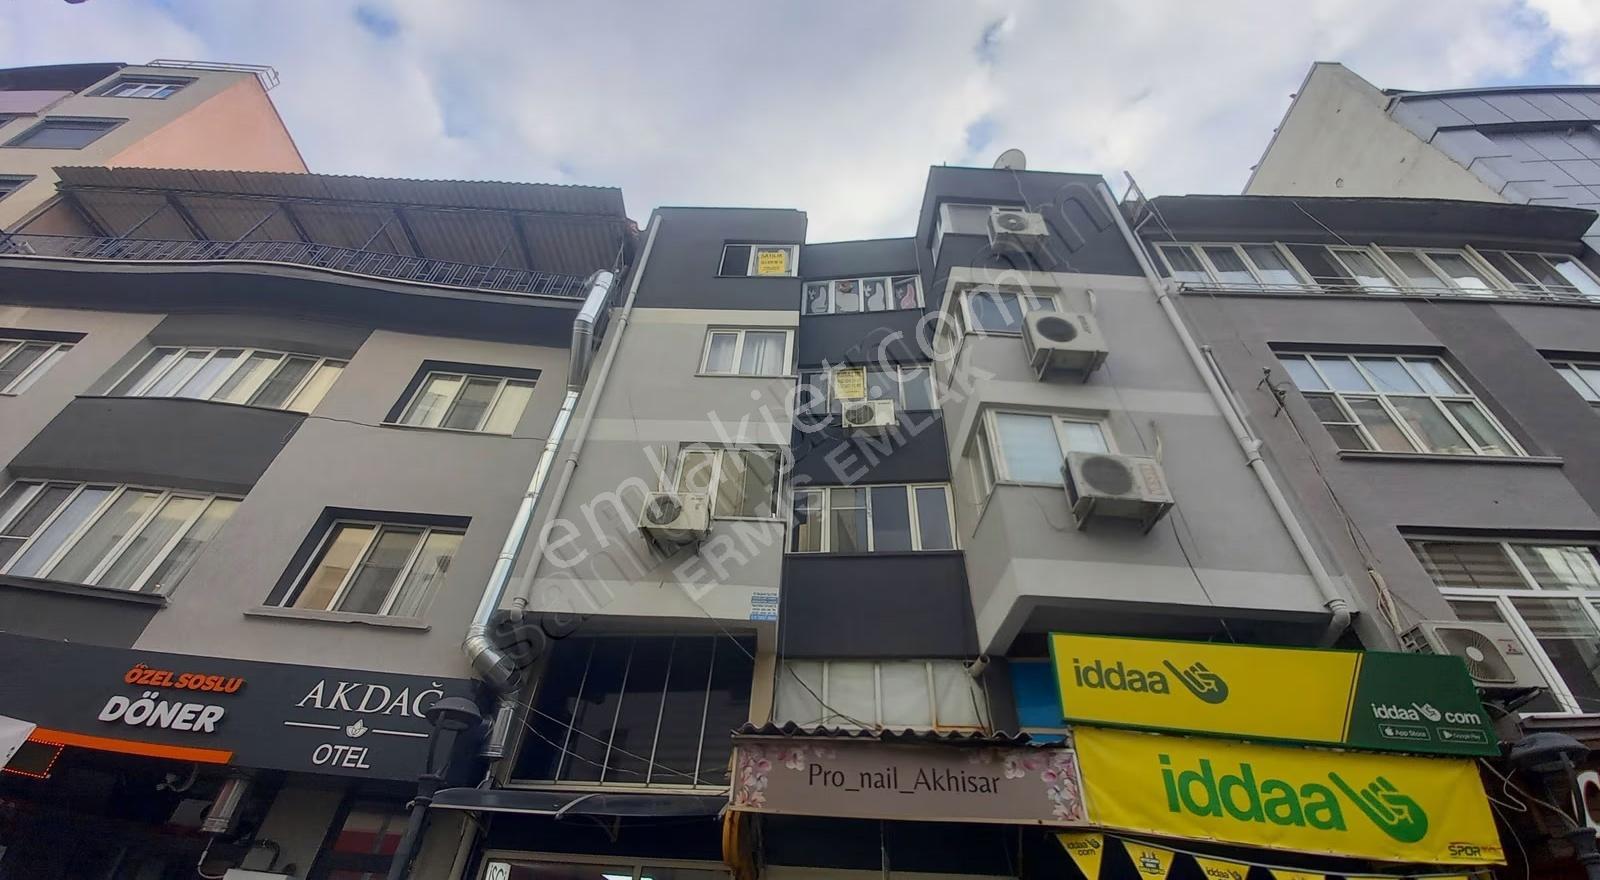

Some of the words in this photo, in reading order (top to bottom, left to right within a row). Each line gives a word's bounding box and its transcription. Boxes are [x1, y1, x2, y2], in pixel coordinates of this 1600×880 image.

[124, 663, 174, 687] ÖZEL
[176, 673, 245, 693] SOSLU
[1073, 658, 1170, 694] iddaa
[98, 691, 225, 733] DÖNER
[296, 680, 444, 719] AKDAĞ
[1371, 703, 1420, 721] iddaa
[1444, 712, 1481, 724] com
[312, 744, 371, 769] OTEL
[808, 763, 1001, 795] Pro_nail_Akhisar
[1158, 754, 1347, 831] iddaa
